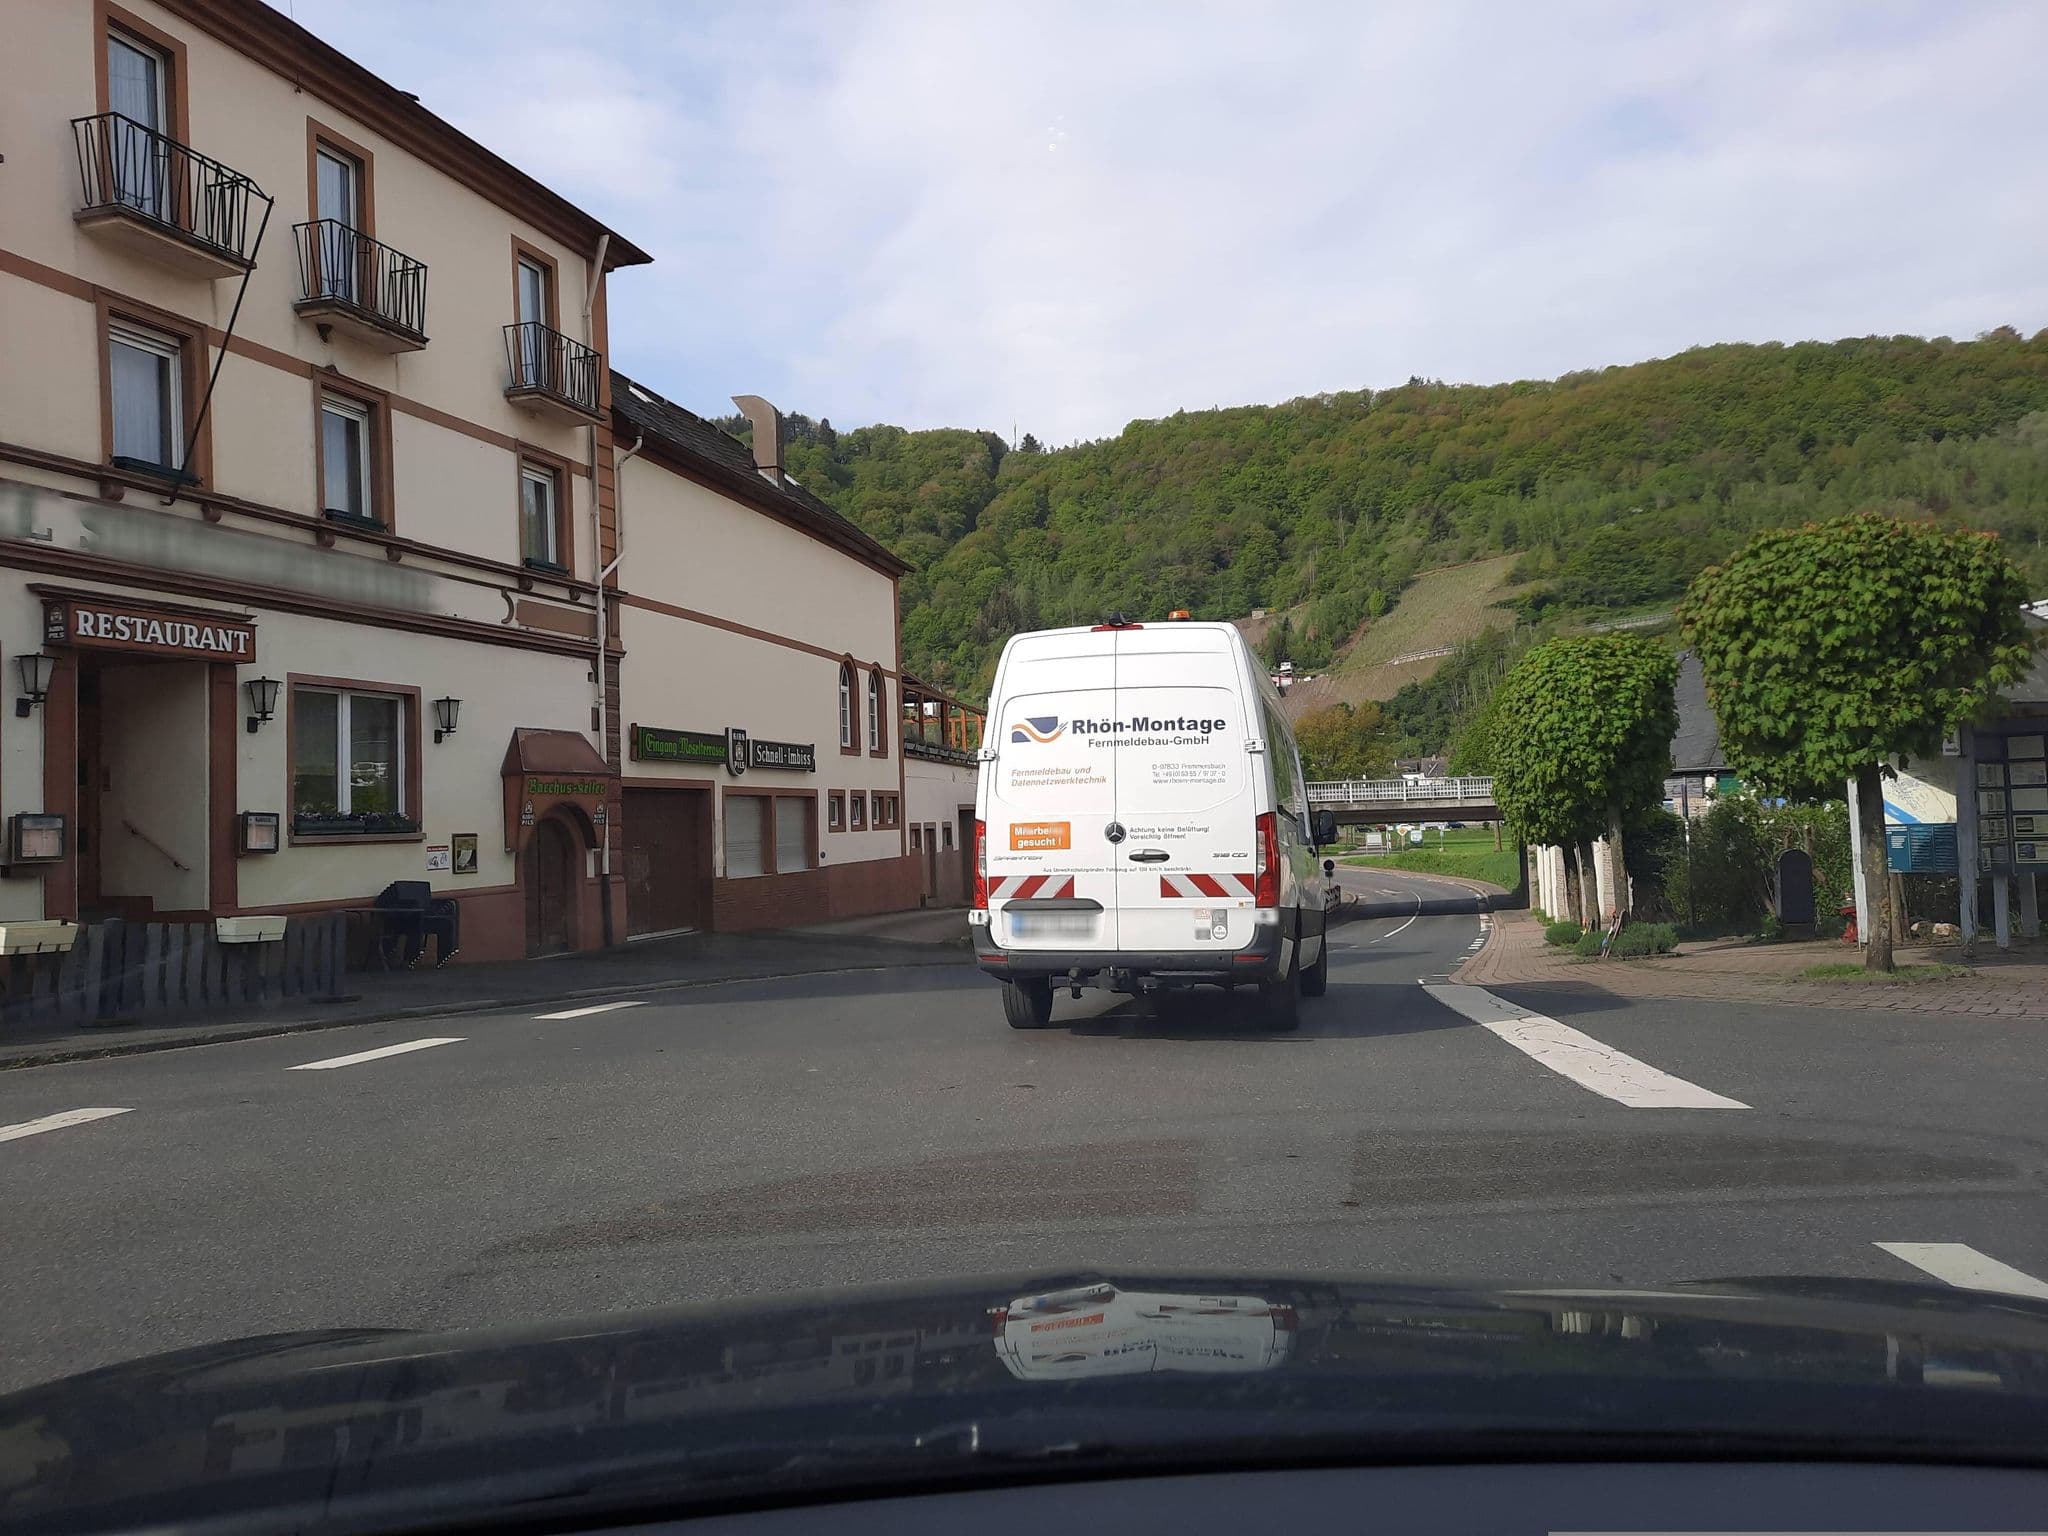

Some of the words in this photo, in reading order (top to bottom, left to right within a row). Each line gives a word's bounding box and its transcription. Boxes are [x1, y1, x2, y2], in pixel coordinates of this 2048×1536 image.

[75, 609, 250, 655] RESTAURANT
[1072, 716, 1226, 734] Rhön-Montage
[1088, 735, 1209, 748] Fernmeldebau-GmbH
[734, 760, 745, 769] PILS
[1011, 767, 1072, 777] Fernmeldebau
[1074, 766, 1092, 775] und
[1011, 775, 1108, 787] Datennetzwerktechnik
[1014, 826, 1065, 836] Mirbei
[1017, 837, 1056, 848] gesucht
